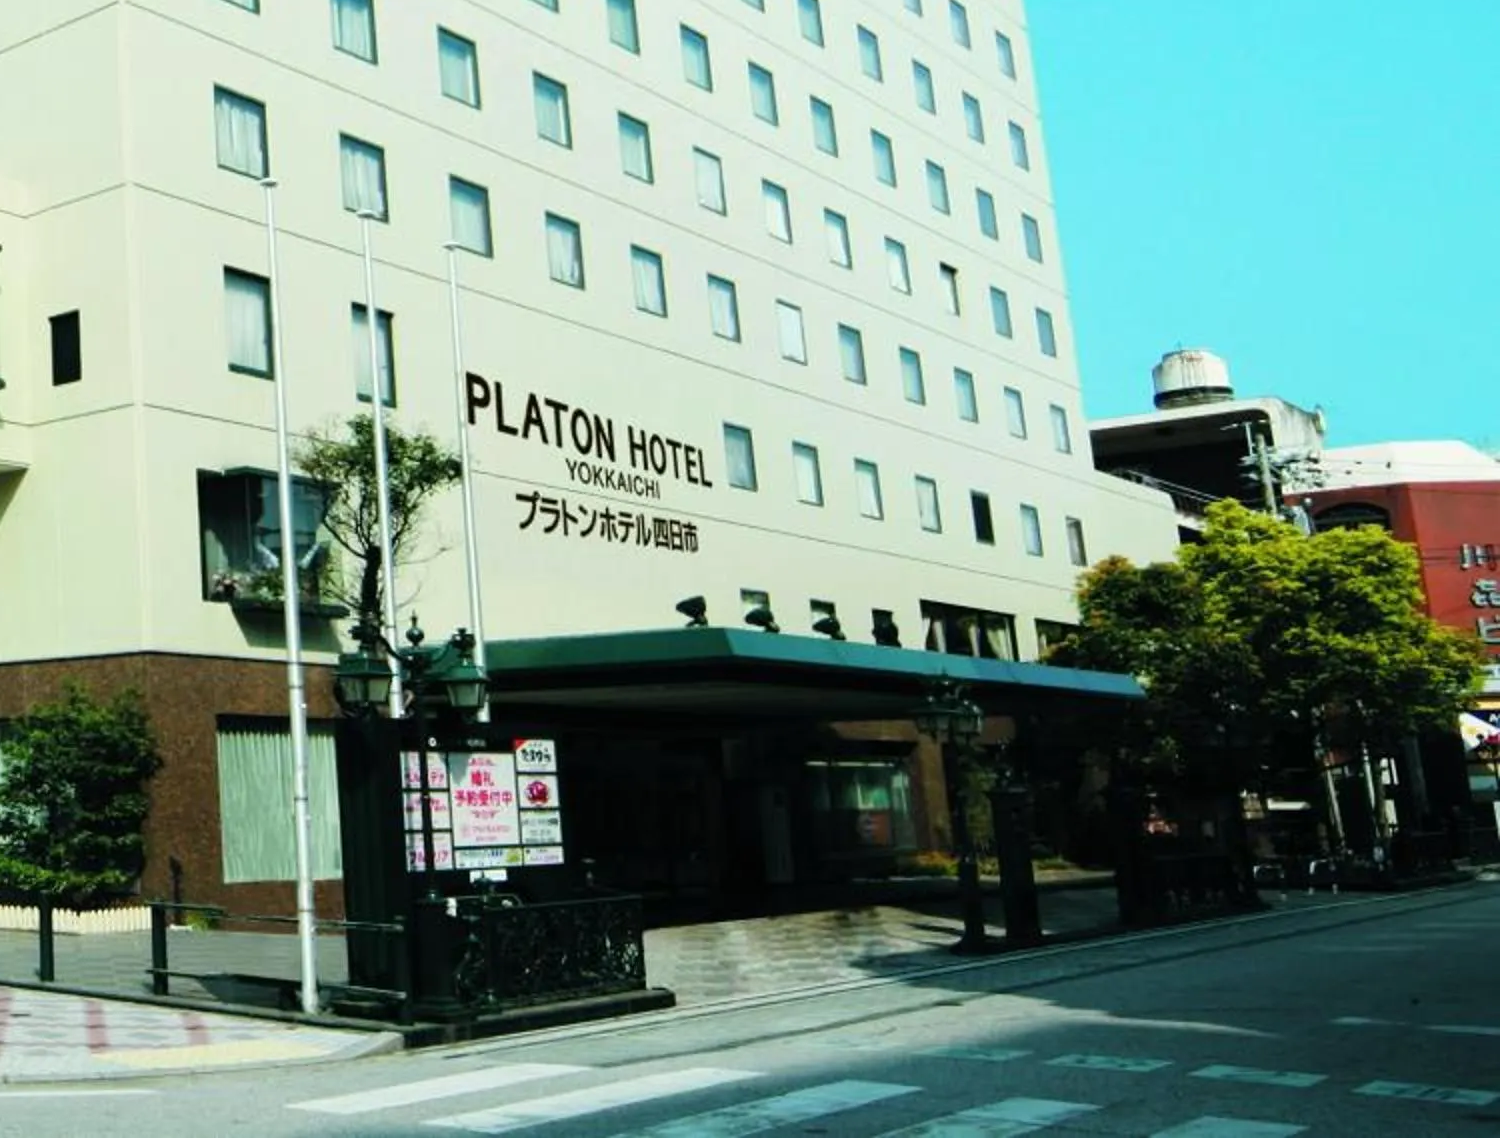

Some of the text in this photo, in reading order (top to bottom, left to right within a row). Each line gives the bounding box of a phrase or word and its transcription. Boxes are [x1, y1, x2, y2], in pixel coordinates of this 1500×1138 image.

[465, 370, 713, 488] PLATON HOTEL
[565, 458, 661, 500] YOKKAICHI
[515, 491, 699, 553] プラトンホテル四日市
